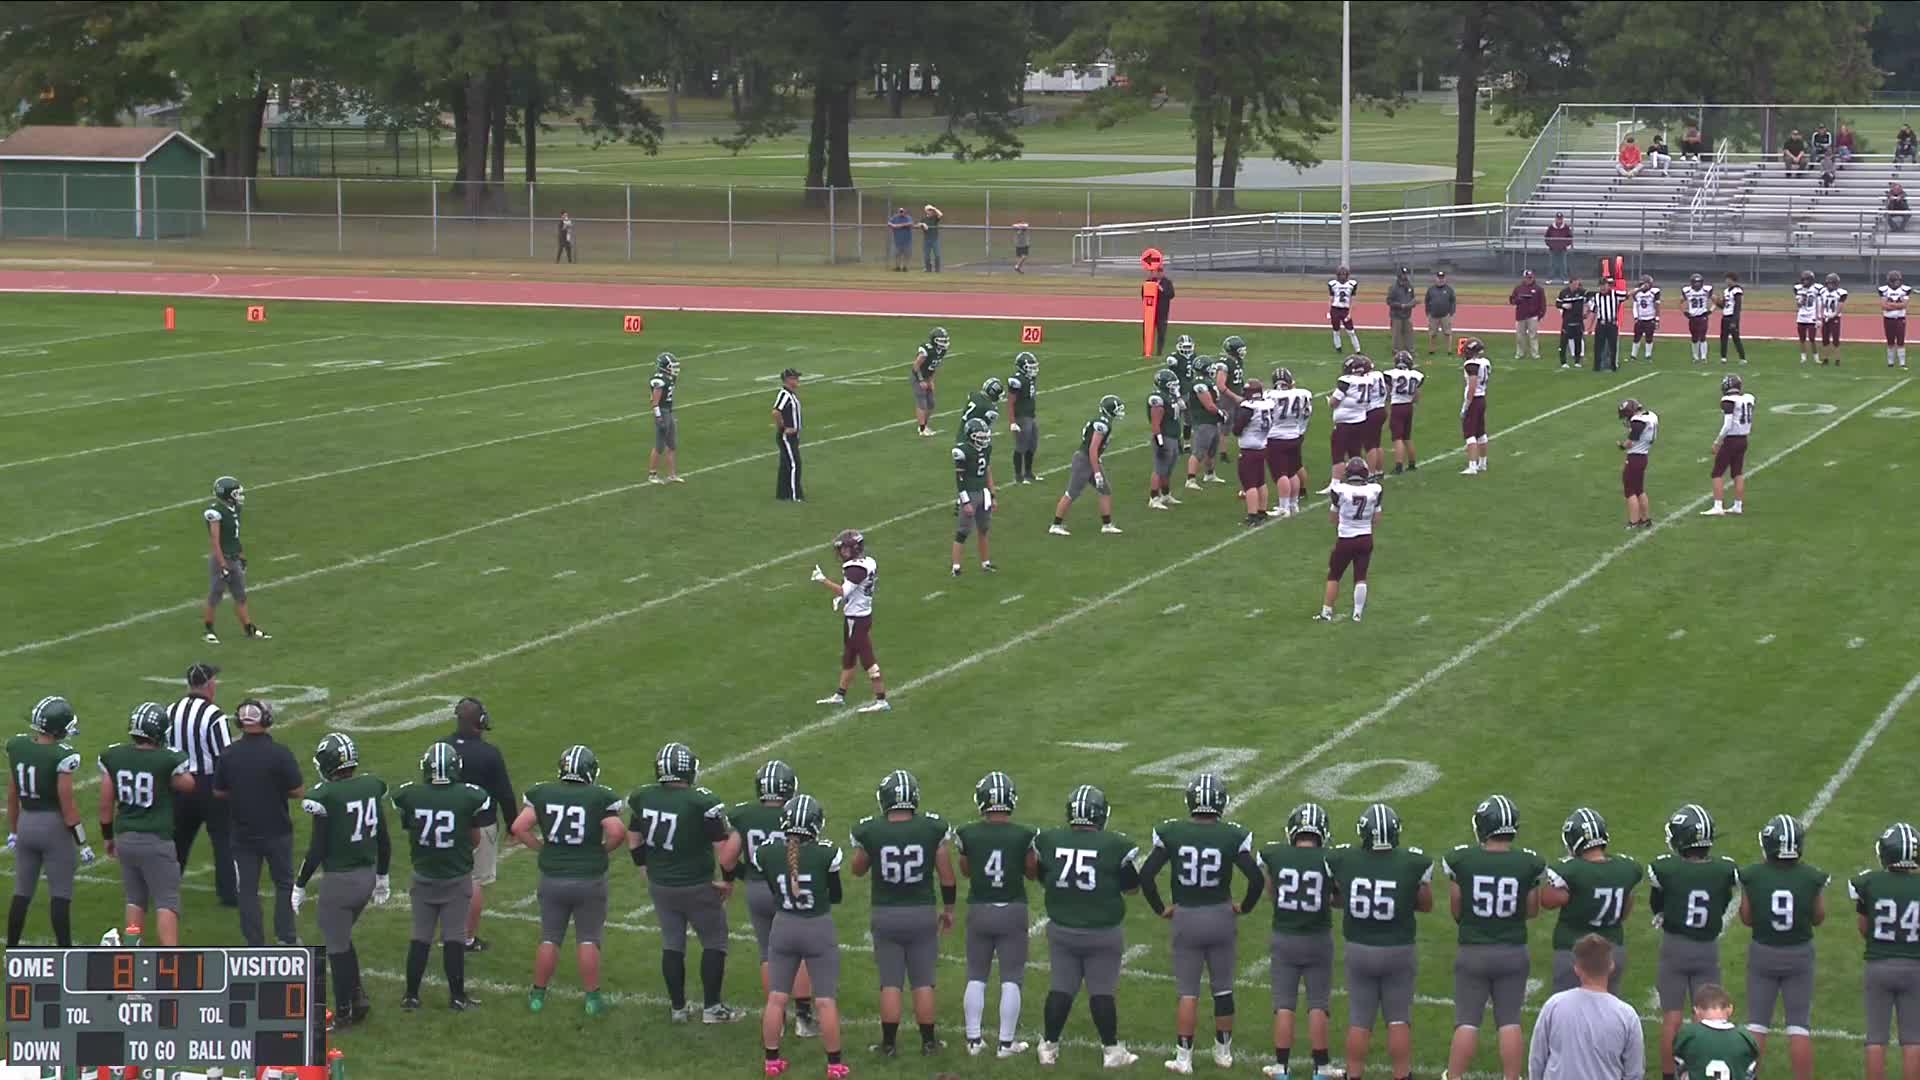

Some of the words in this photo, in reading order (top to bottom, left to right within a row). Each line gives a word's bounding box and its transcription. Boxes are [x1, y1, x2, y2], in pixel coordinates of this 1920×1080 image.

[625, 317, 640, 331] 10
[1024, 327, 1041, 341] 20
[1277, 395, 1301, 420] 74
[977, 458, 987, 476] 2
[1352, 495, 1368, 521] 7
[17, 762, 40, 800] 11
[116, 770, 154, 808] 68
[347, 798, 378, 842] 74
[414, 808, 456, 849] 72
[545, 804, 587, 845] 73
[641, 809, 679, 851] 77
[880, 844, 924, 884] 62
[984, 849, 1004, 888] 4
[1055, 848, 1098, 891] 75
[1177, 845, 1223, 888] 32
[776, 873, 815, 910] 15
[1277, 867, 1324, 912] 23
[1349, 877, 1397, 921] 65
[1472, 875, 1518, 918] 58
[1589, 887, 1625, 927] 71
[1685, 889, 1710, 928] 6
[1771, 889, 1795, 931] 9
[1873, 898, 1920, 942] 24
